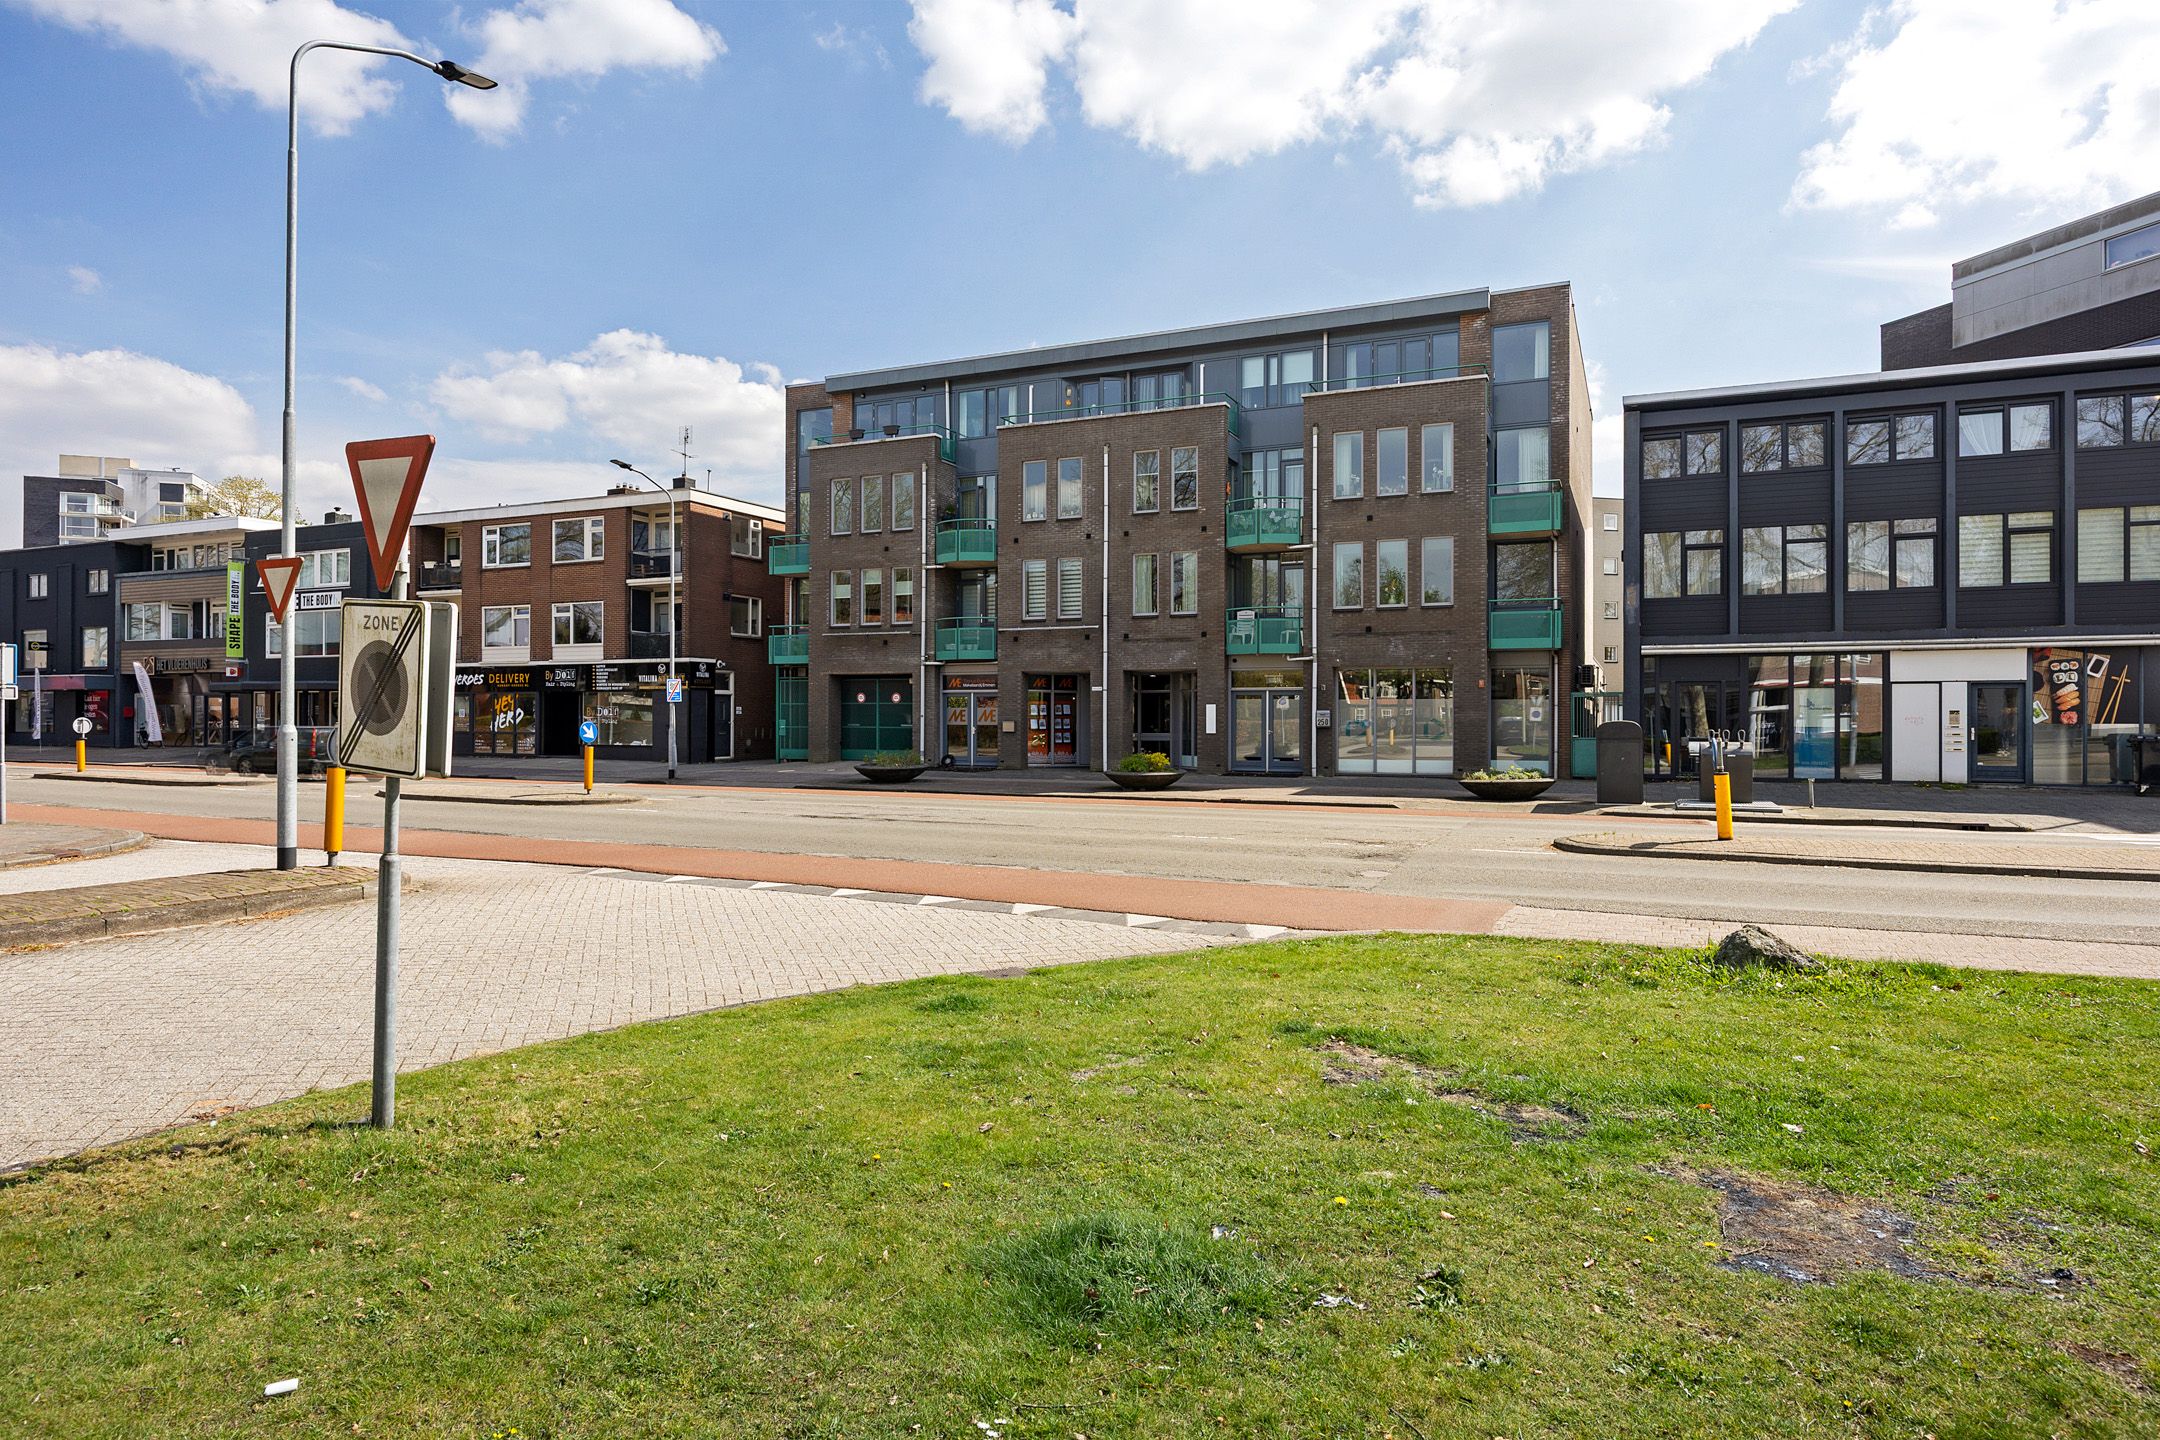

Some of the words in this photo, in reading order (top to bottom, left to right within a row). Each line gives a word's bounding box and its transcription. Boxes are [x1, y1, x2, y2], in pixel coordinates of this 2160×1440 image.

[230, 580, 240, 599] BODY
[302, 595, 314, 606] THE
[316, 594, 333, 606] BODY
[230, 602, 240, 613] THE
[363, 615, 399, 631] ZONE
[229, 617, 240, 649] SHAPE
[156, 659, 166, 671] HET
[488, 673, 530, 683] DELIVERY
[545, 670, 553, 681] By
[555, 669, 576, 680] Dolf
